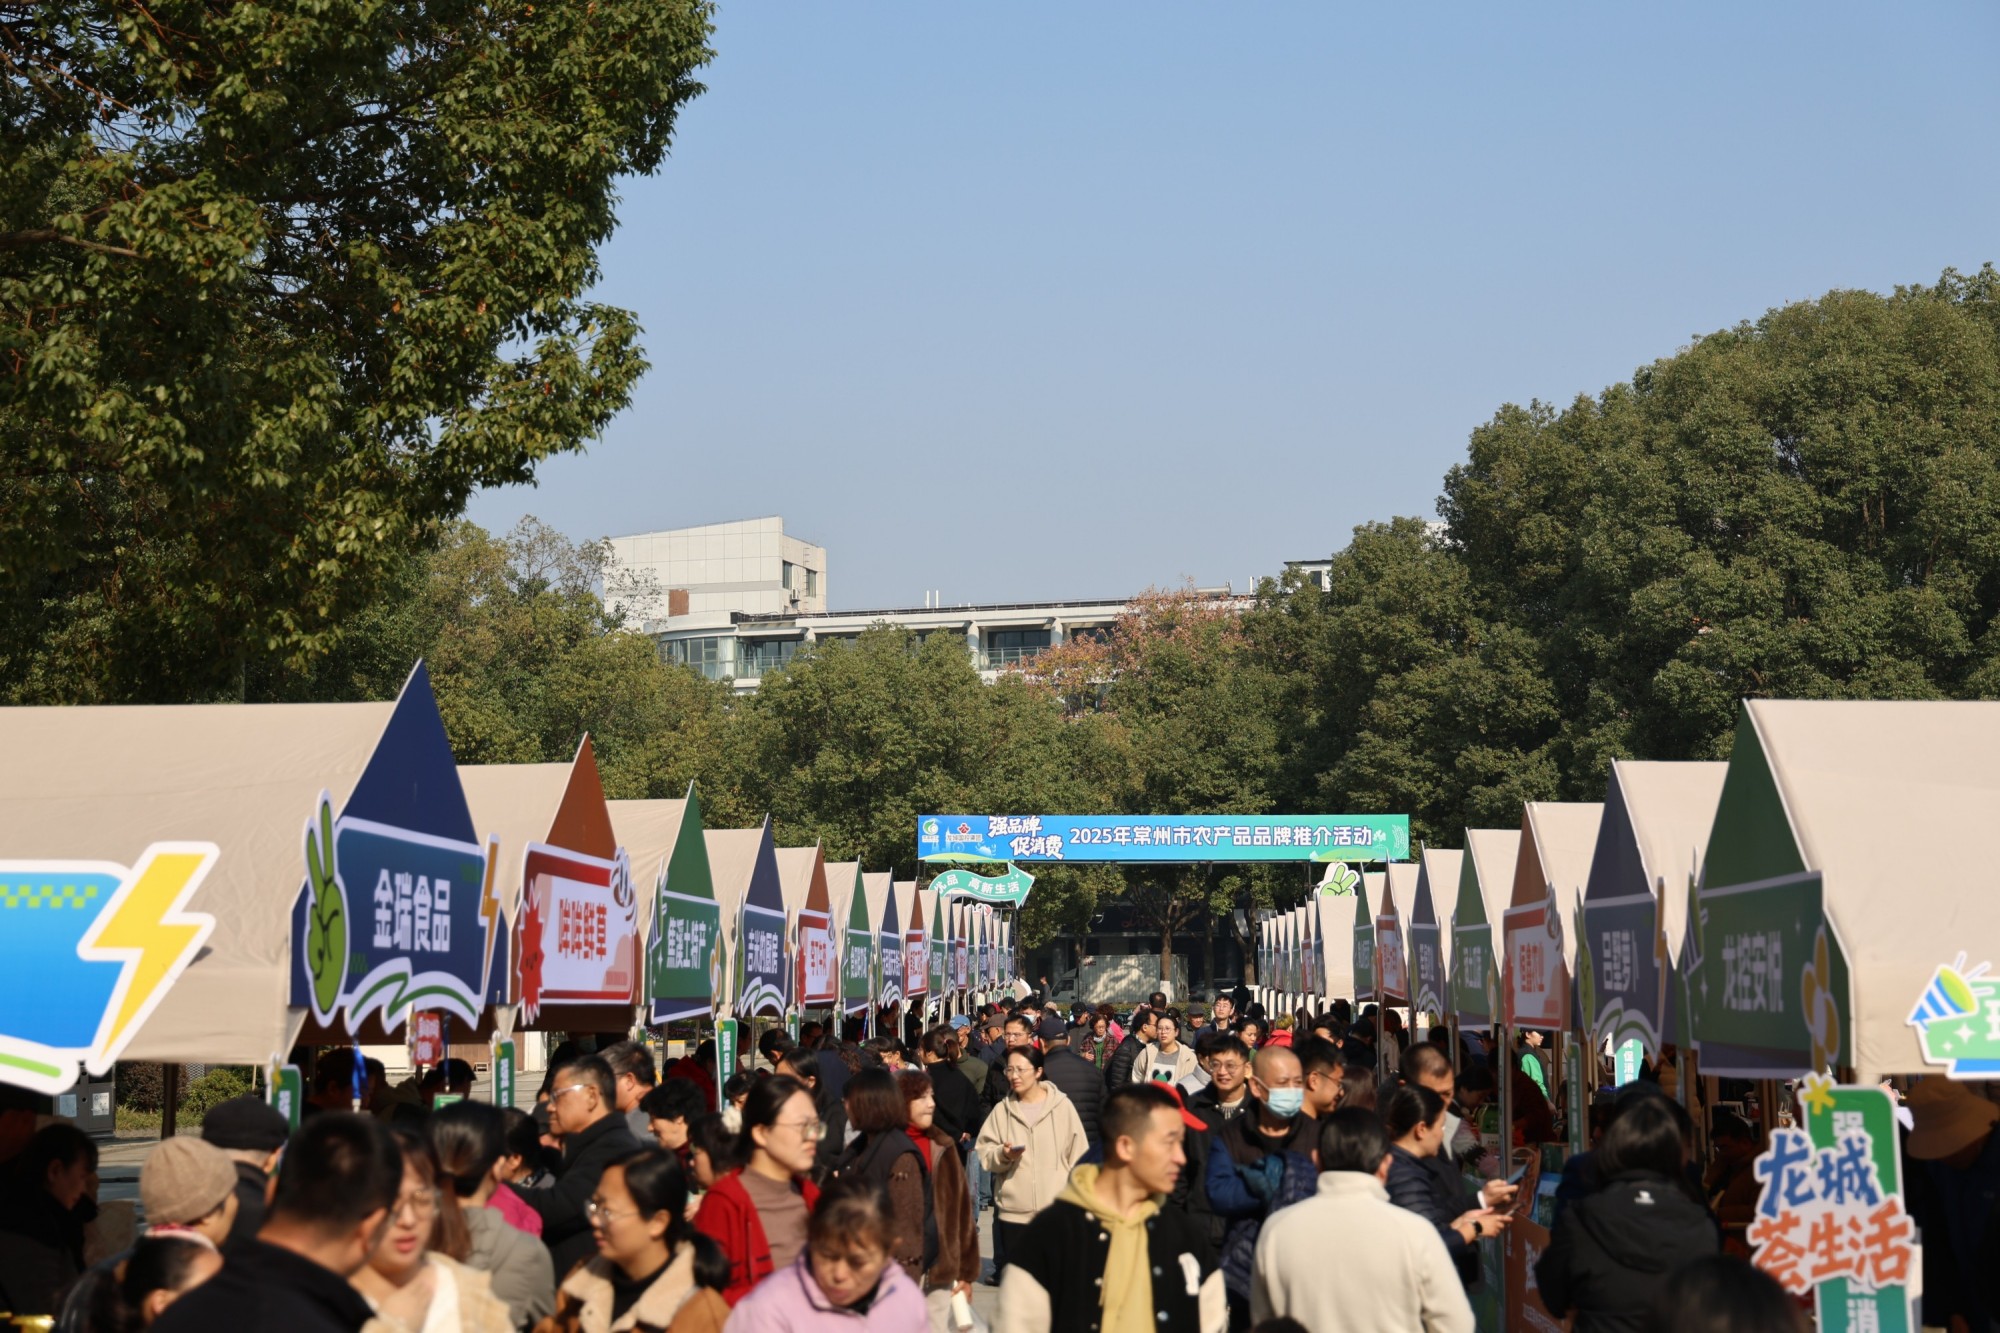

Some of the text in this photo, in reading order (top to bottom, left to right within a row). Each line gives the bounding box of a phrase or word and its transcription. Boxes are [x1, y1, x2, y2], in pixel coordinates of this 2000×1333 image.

[988, 816, 1042, 837] 强品牌
[1010, 836, 1064, 859] 促消费
[1069, 826, 1372, 846] 2025年常州市农产品品牌推介活动
[373, 868, 451, 952] 金瑞食品
[667, 917, 706, 969] 焦溪土特产
[1722, 931, 1784, 1013] 龙控安悦
[1759, 1133, 1879, 1219] 龙城
[1752, 1200, 1911, 1289] 荟生活
